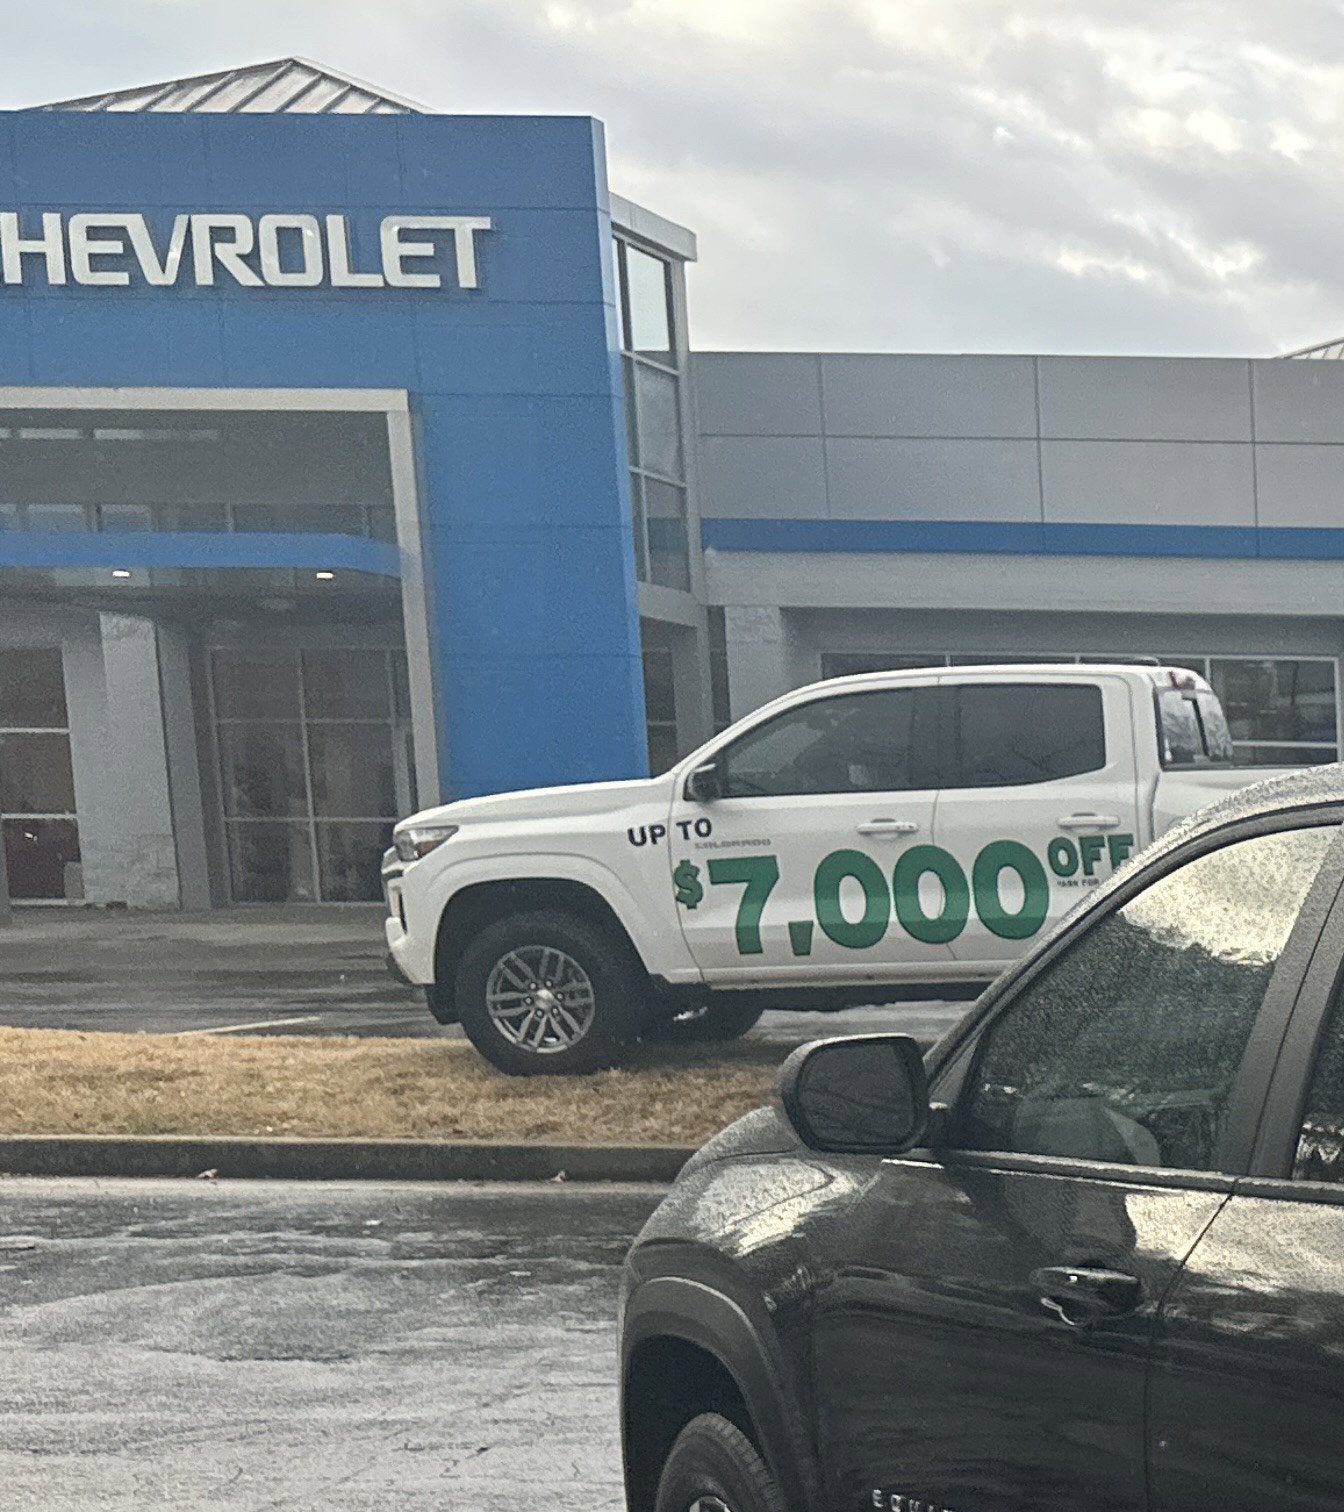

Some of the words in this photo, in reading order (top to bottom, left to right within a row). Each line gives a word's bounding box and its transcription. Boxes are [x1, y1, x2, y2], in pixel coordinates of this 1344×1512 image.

[0, 212, 492, 289] HEVROLET
[627, 825, 667, 847] UP
[675, 818, 713, 840] TO
[1047, 833, 1134, 878] OFF
